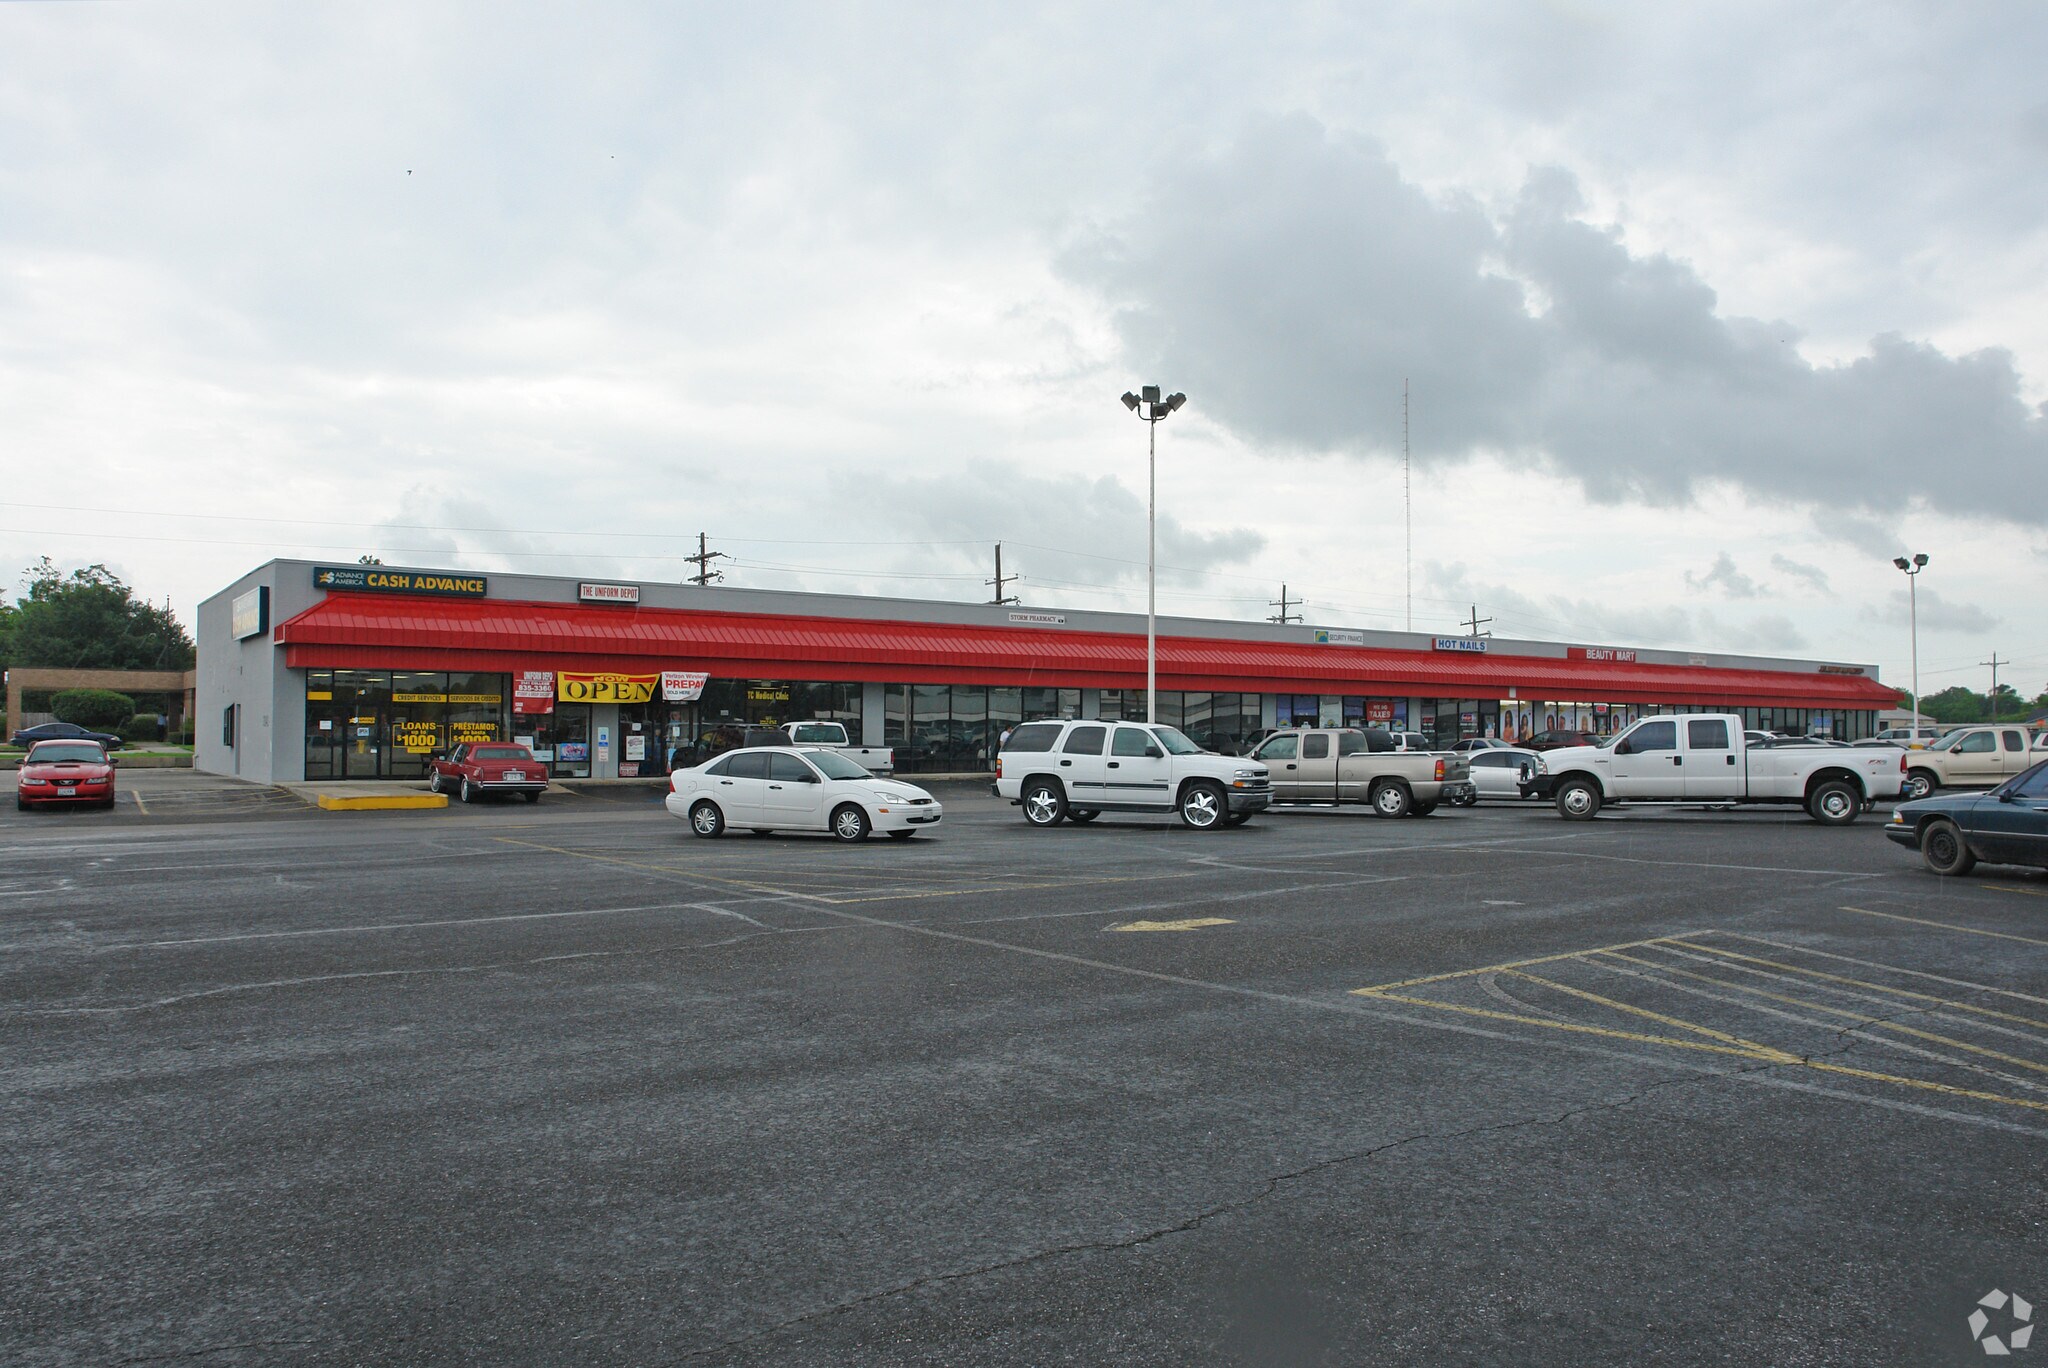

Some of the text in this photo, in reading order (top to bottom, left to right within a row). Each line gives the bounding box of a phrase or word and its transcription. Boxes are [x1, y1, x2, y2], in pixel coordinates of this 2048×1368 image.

[367, 574, 484, 592] CASH ADVANCE
[583, 586, 637, 598] THE UNIFORM DEPOT
[1438, 639, 1486, 650] HOT NAILS
[1586, 650, 1634, 661] BEAUTY MART
[565, 682, 652, 699] OPEN
[748, 691, 754, 699] TC
[756, 691, 775, 700] Medical
[1369, 710, 1391, 718] TAXES
[401, 722, 436, 730] LOANS
[397, 735, 436, 746] $1000
